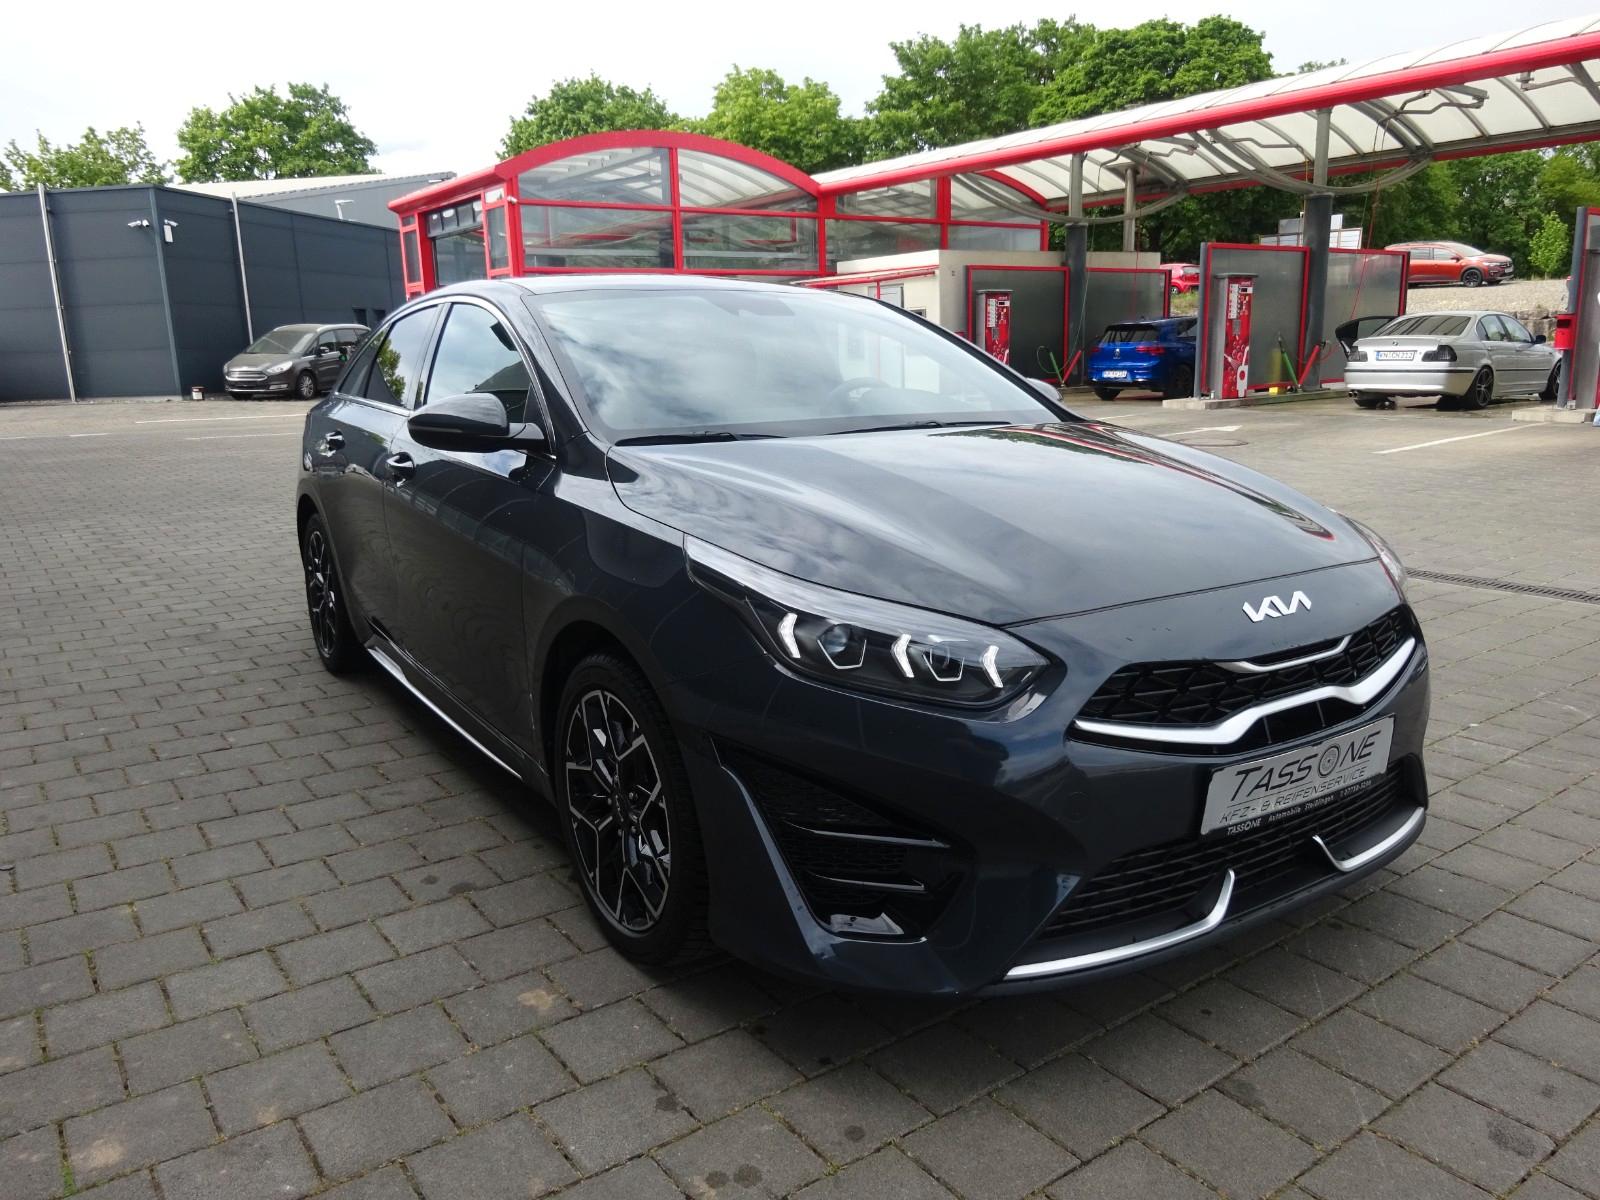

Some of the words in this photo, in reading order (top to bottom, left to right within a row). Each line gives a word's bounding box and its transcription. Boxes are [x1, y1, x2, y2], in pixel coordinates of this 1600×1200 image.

[1242, 590, 1312, 623] KIA
[1231, 730, 1382, 801] TASSONE
[1273, 766, 1367, 808] REIFENSERVICE
[1227, 818, 1262, 836] TASSONE
